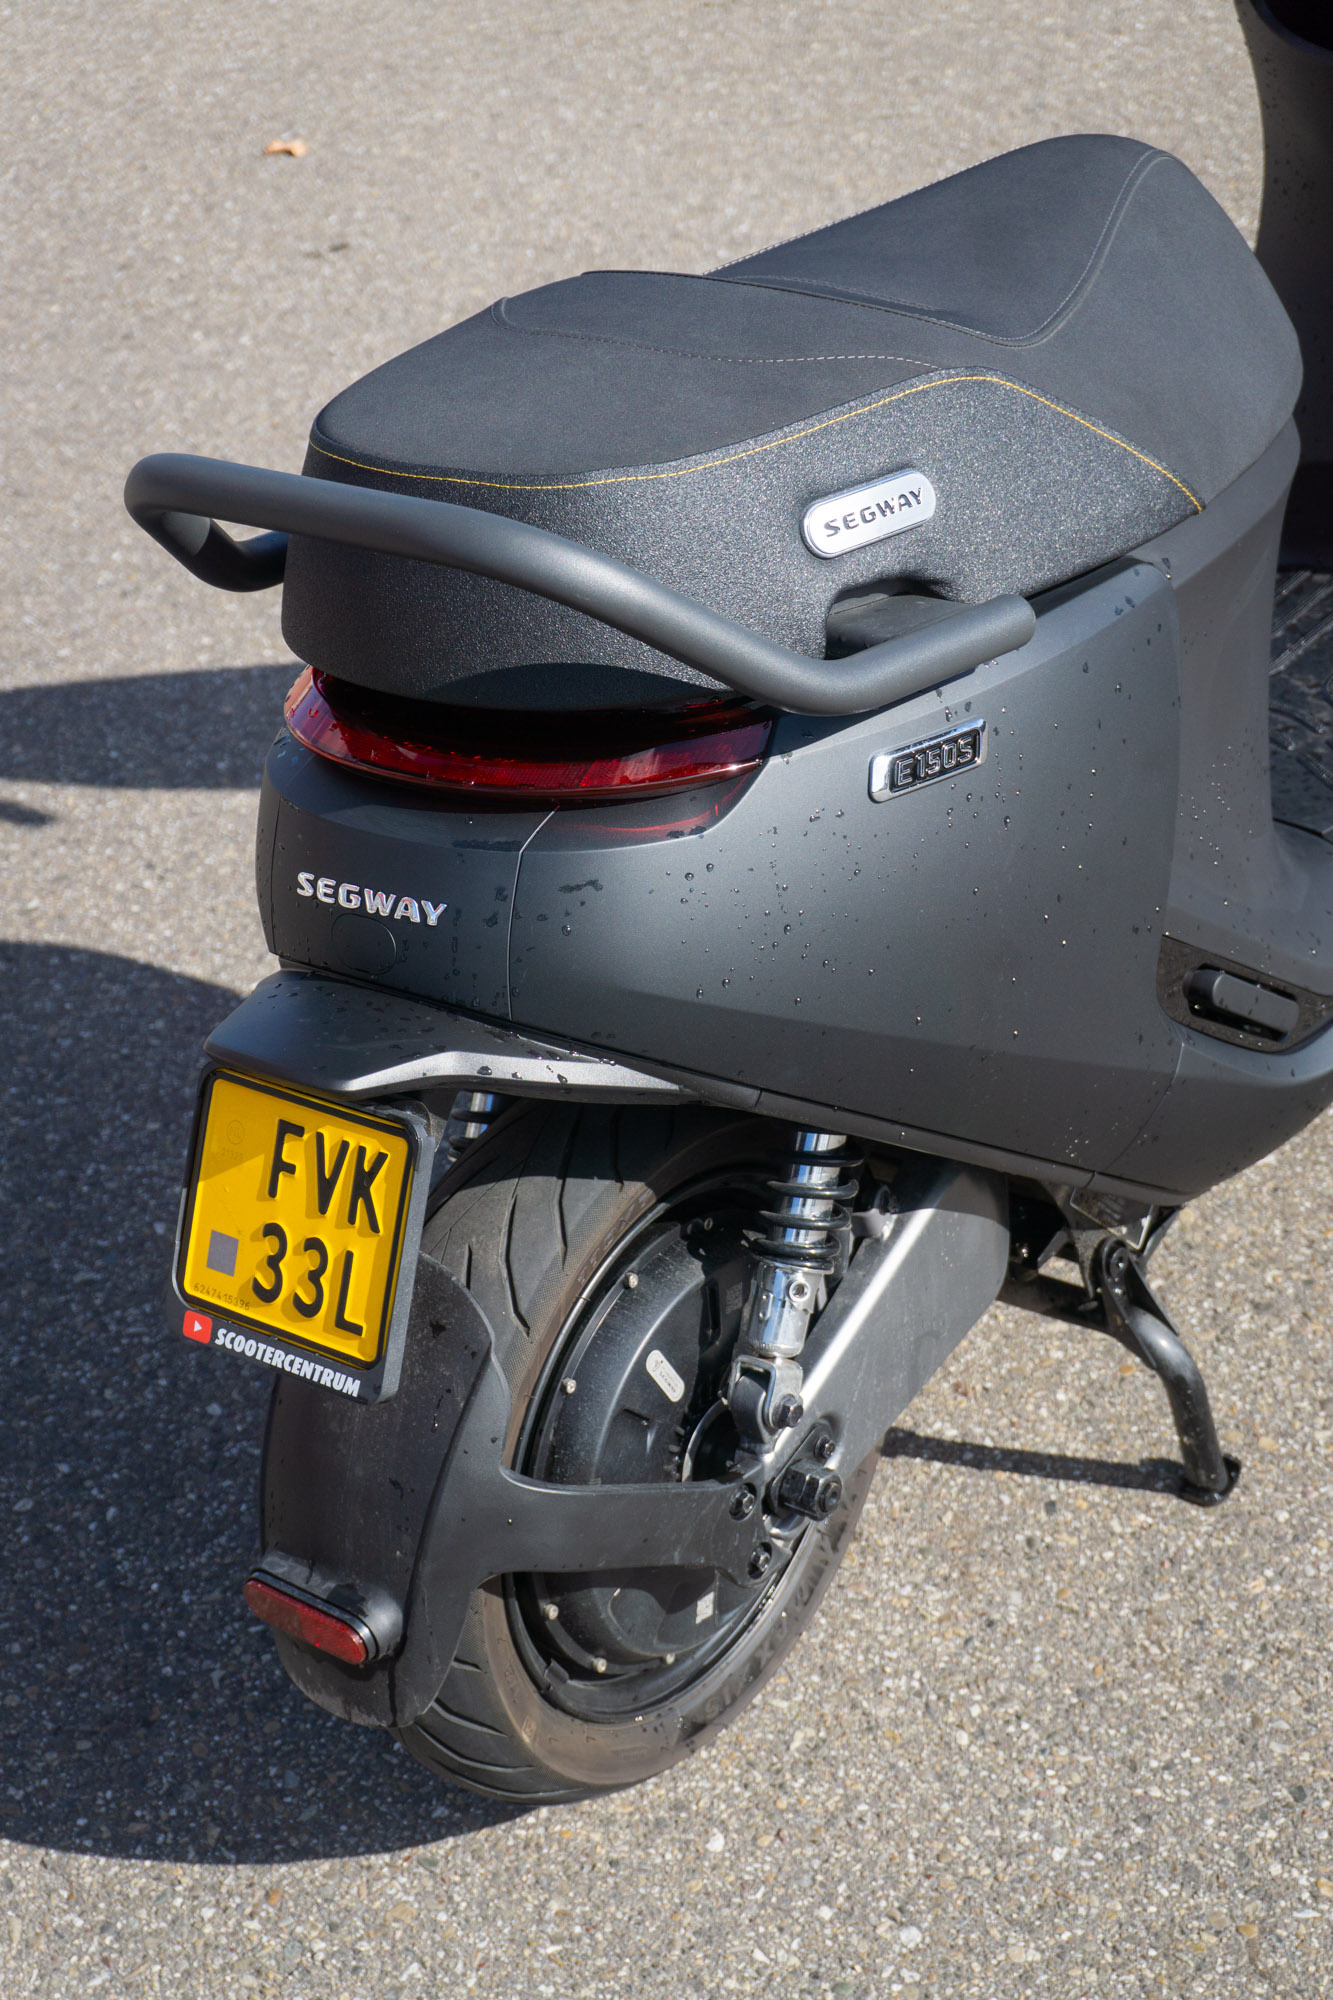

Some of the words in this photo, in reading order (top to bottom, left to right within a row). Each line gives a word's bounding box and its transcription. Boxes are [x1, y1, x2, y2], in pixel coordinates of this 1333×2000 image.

[823, 487, 924, 538] SEGWAY
[895, 735, 973, 786] E150S
[296, 871, 448, 926] SEGWAY
[268, 1118, 389, 1234] FVK
[193, 1282, 251, 1311] 6247415396
[252, 1222, 365, 1338] 33L
[214, 1327, 361, 1398] SCOOTERCENTRUM
